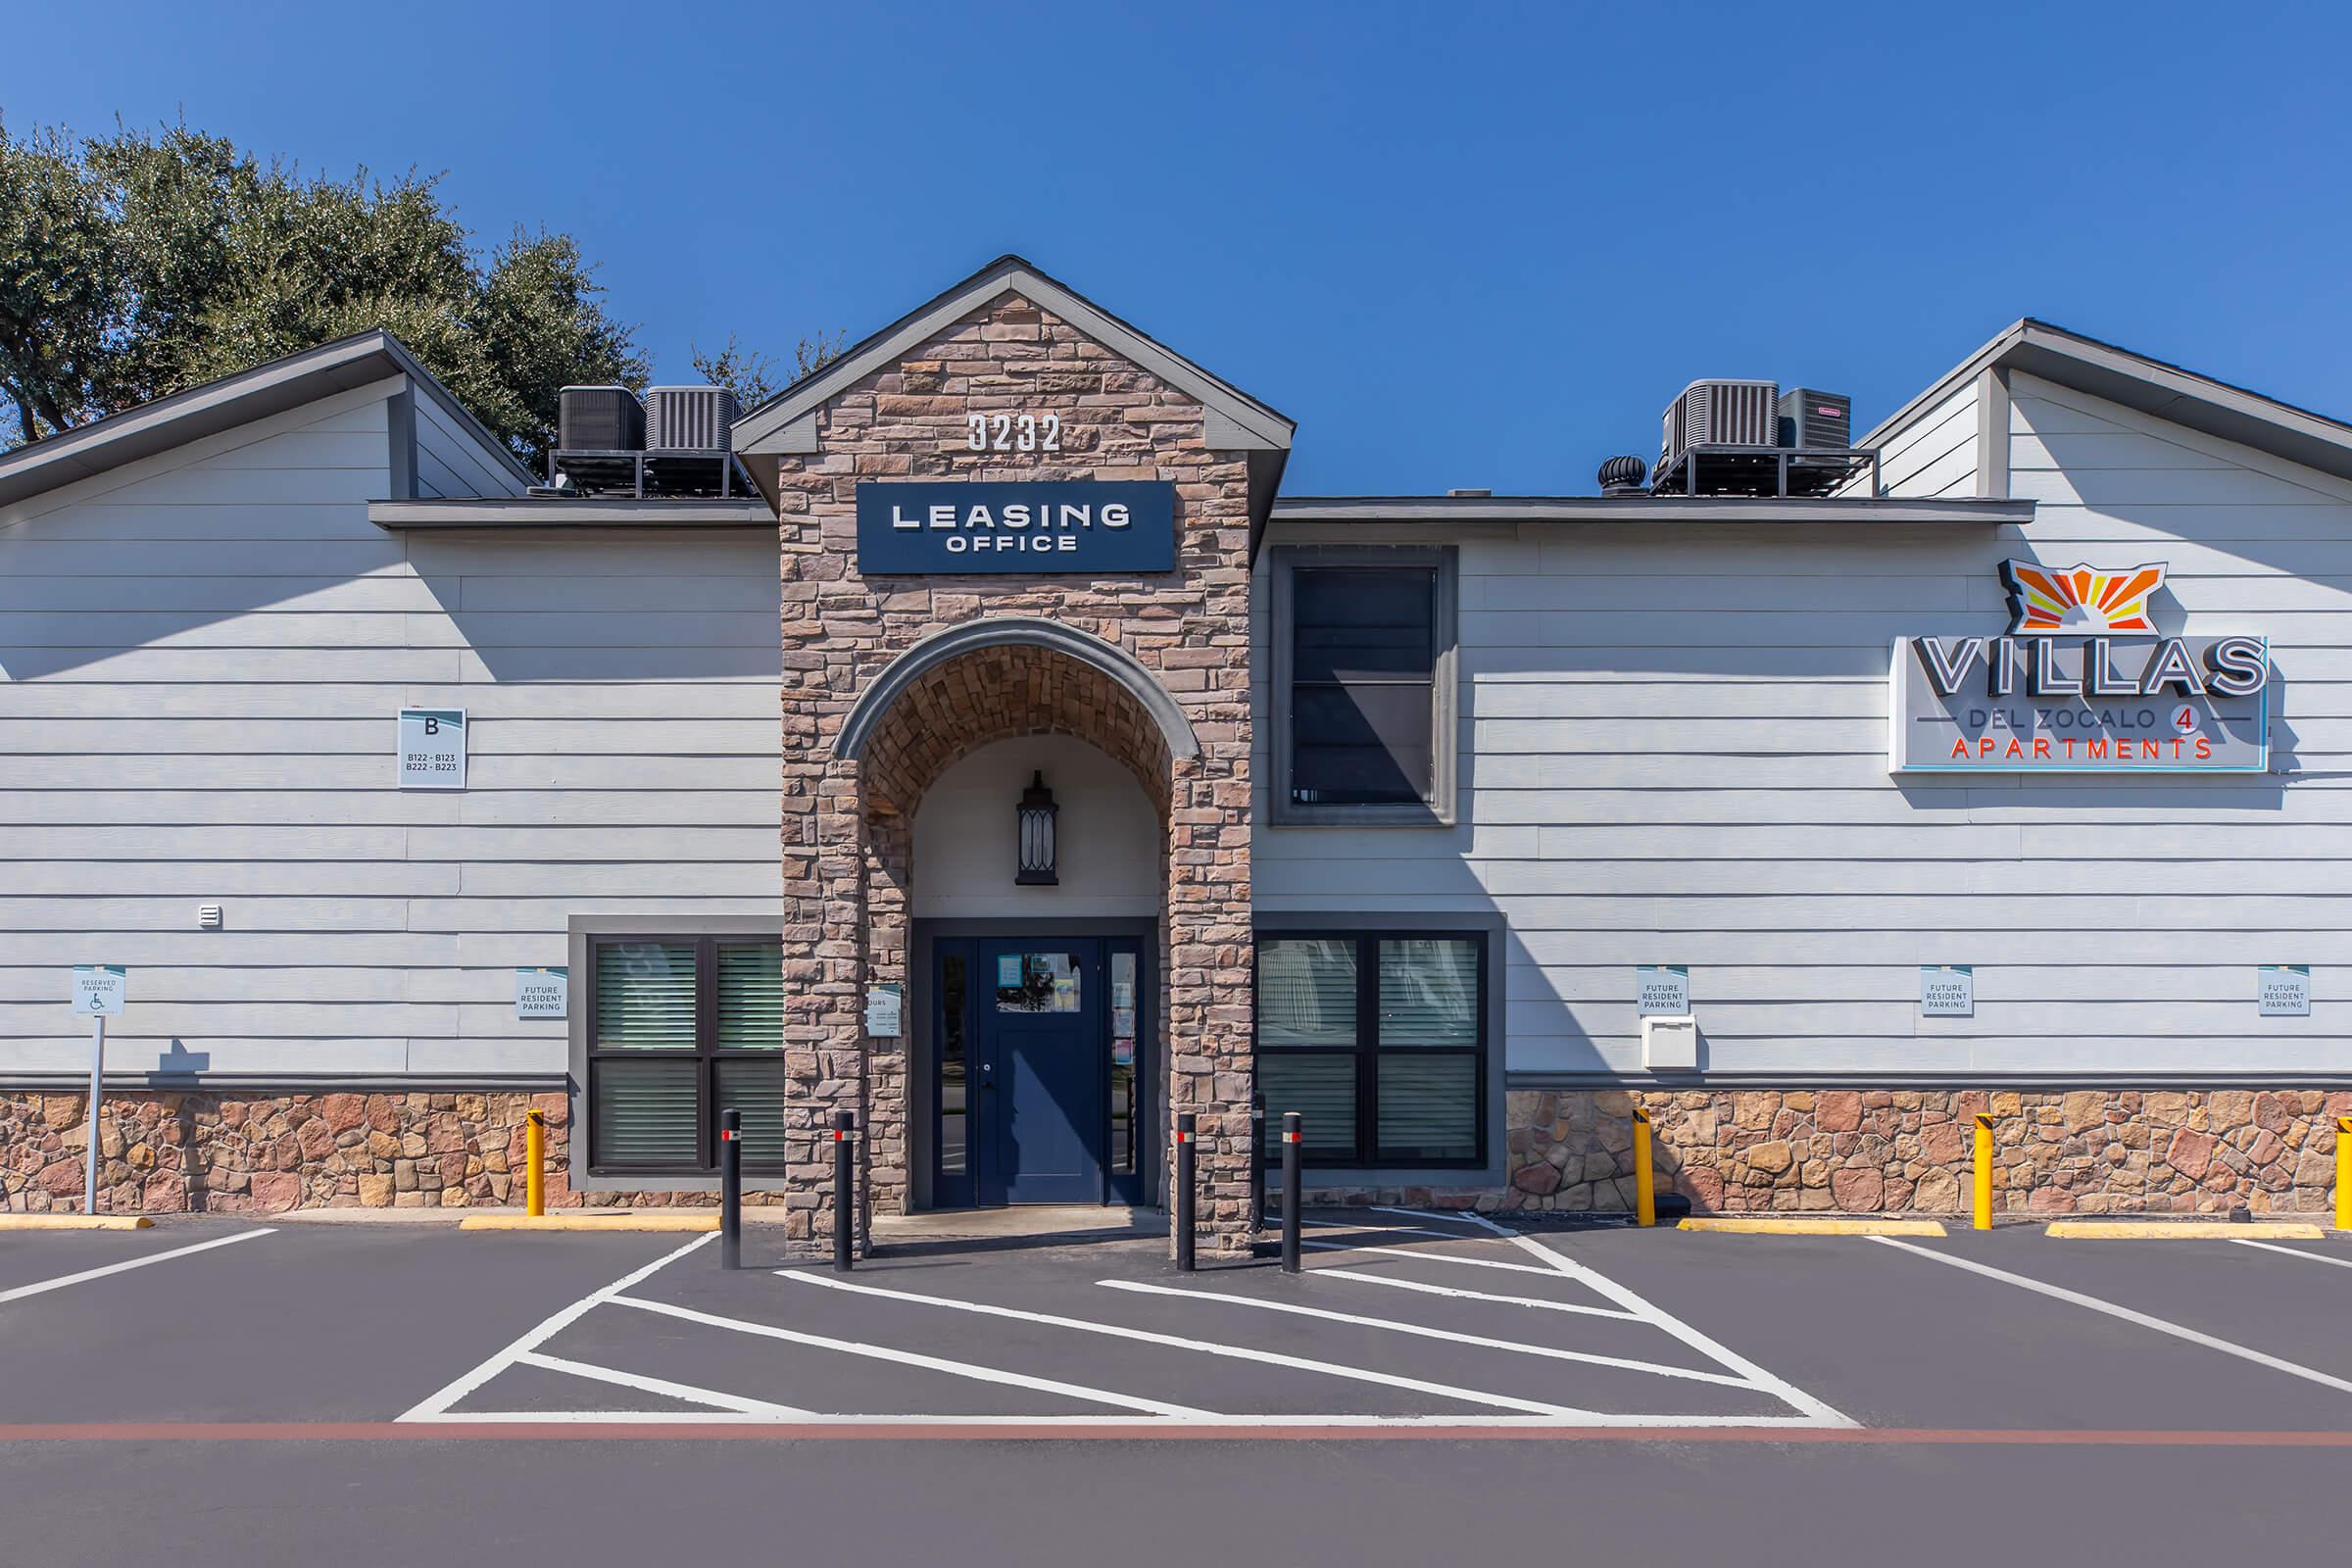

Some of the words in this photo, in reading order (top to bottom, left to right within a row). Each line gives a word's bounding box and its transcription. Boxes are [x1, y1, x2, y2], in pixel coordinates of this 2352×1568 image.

[968, 414, 1060, 452] 3232
[892, 504, 1130, 528] LEASING
[946, 535, 1077, 553] OFFICE
[1912, 636, 2270, 697] VILLAS
[424, 717, 439, 736] B
[1969, 710, 2025, 729] DEL
[2036, 709, 2155, 730] ZOCALO
[2176, 708, 2192, 730] 4
[435, 754, 456, 762] B123
[1951, 738, 2212, 760] APARTMENTS
